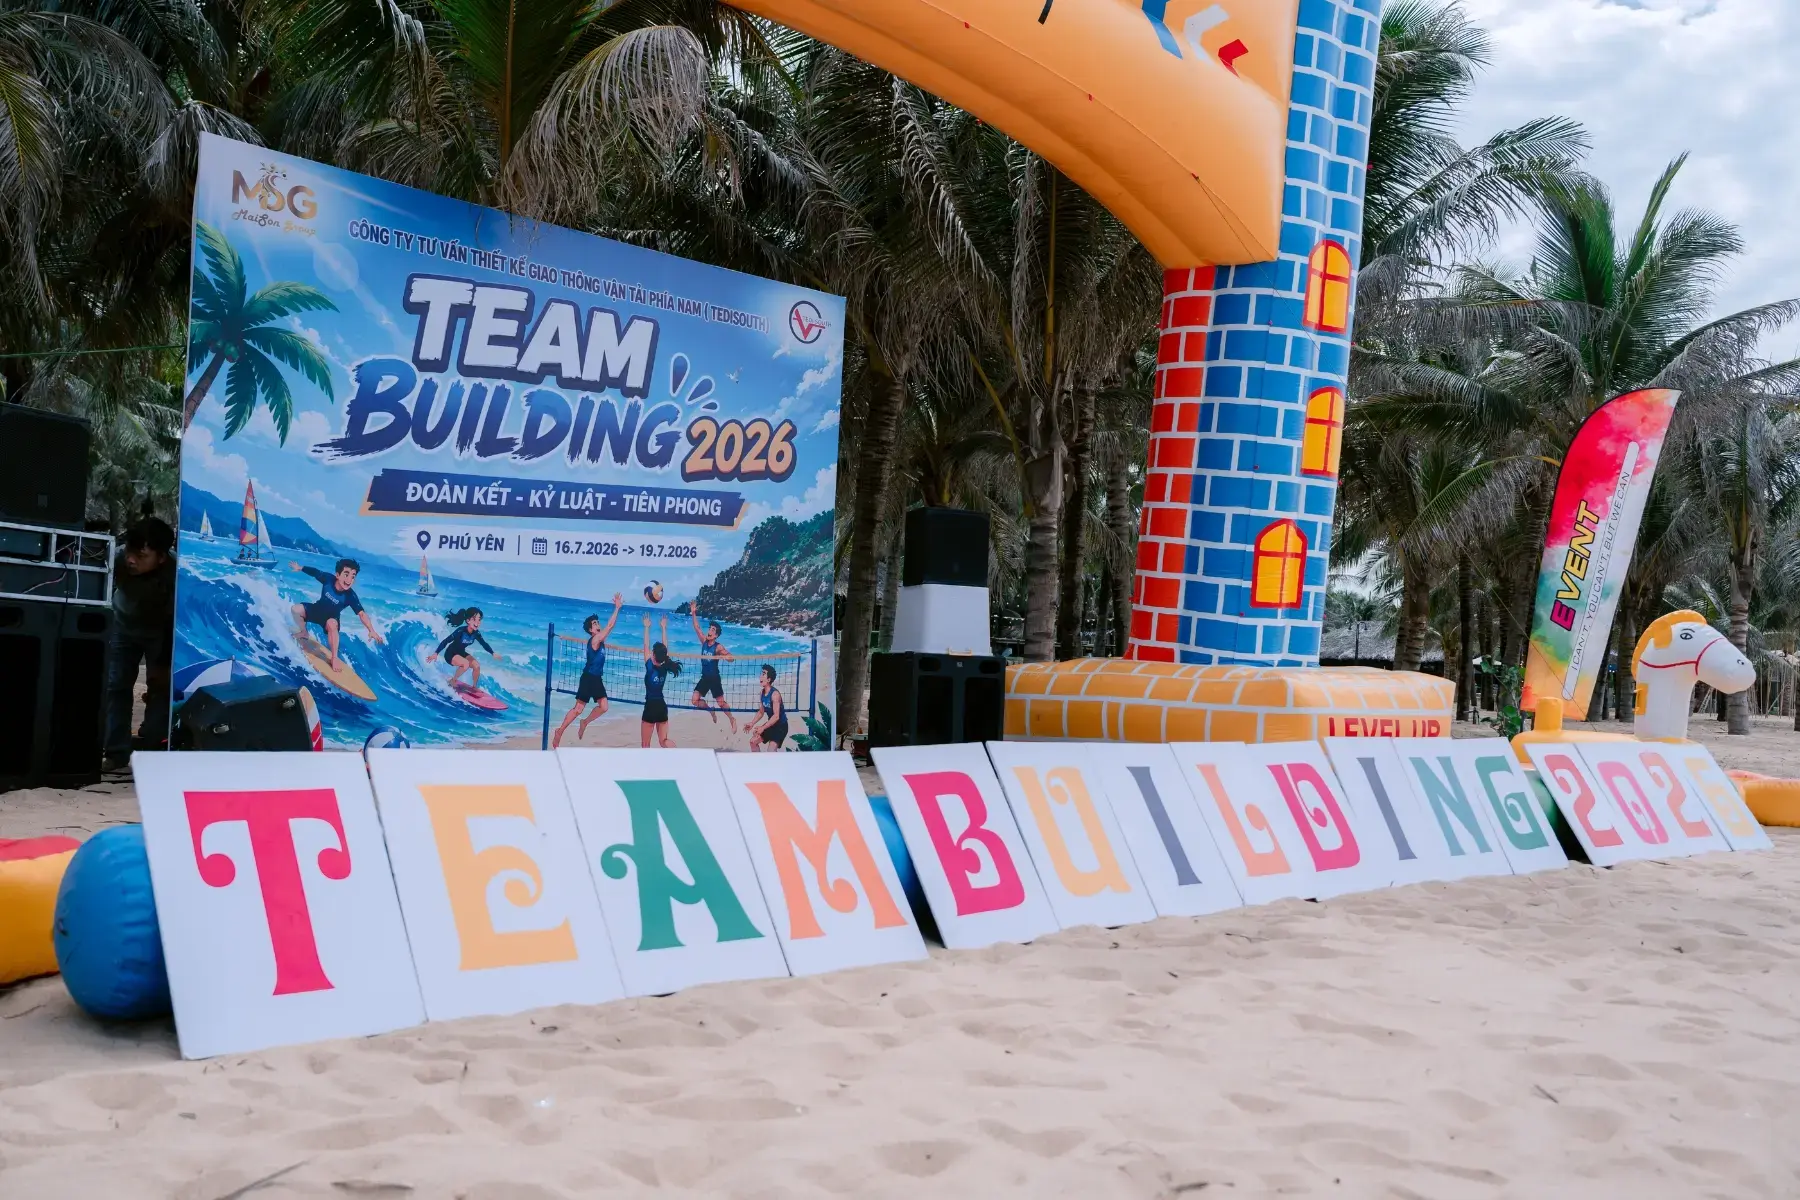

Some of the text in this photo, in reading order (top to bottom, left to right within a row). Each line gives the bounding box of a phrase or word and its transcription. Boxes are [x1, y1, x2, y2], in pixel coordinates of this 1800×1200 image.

[232, 168, 318, 220] MSG
[349, 218, 390, 246] CÔNG
[394, 229, 414, 251] TY
[418, 235, 438, 256] TƯ
[440, 239, 468, 264] VẤN
[470, 248, 508, 273] THIẾT
[509, 256, 527, 277] KẾ
[528, 262, 559, 284] GIAO
[560, 270, 600, 293] THÔNG
[603, 278, 626, 302] VẬN
[629, 283, 647, 305] TẢI
[650, 290, 675, 312] PHÍA
[677, 297, 702, 318] NAM
[405, 273, 660, 397] TEAM
[310, 356, 683, 470] BUILDING
[682, 416, 796, 482] 2026
[406, 479, 468, 504] ĐOÀN
[472, 480, 512, 507] KẾT
[528, 483, 556, 509] KỶ
[559, 488, 606, 516] LUẬT
[623, 491, 661, 513] TIÊN
[664, 496, 722, 517] PHONG
[438, 532, 505, 552] PHÚ YÊN
[554, 540, 619, 557] 16.7.2026
[639, 544, 698, 559] 19.7.2026
[1550, 499, 1600, 632] EVENT
[1586, 595, 1599, 620] YOU
[1603, 523, 1616, 551] BUT
[1611, 502, 1622, 521] WE
[1617, 471, 1630, 500] CAN
[1328, 717, 1400, 737] LEVEL
[183, 751, 1755, 996] TEAM BUILDING 2026
